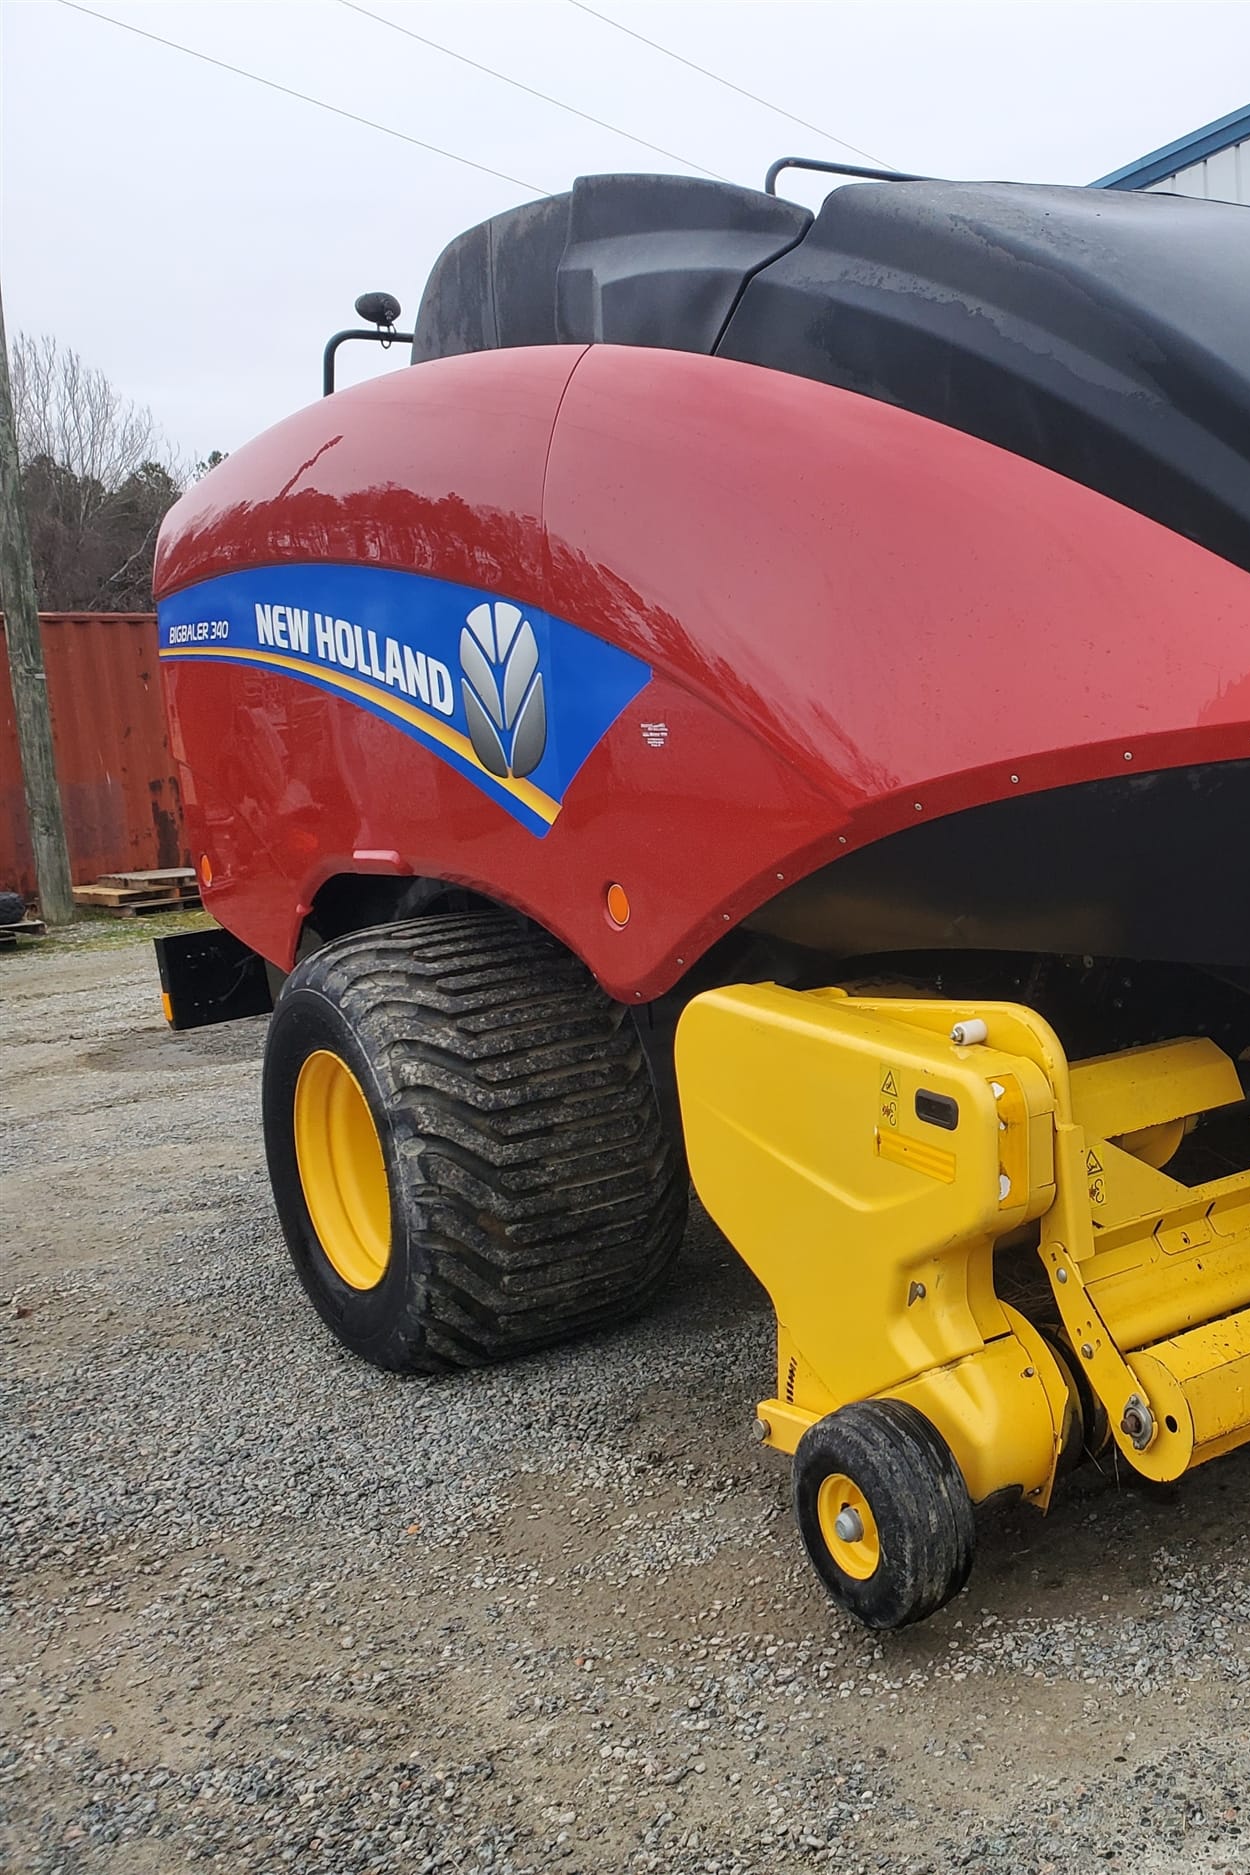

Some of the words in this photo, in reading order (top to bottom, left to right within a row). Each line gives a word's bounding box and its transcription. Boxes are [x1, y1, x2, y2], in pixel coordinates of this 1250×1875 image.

[169, 622, 209, 644] BIGBALER
[210, 620, 229, 640] 340
[255, 603, 309, 654] NEW
[314, 612, 454, 716] HOLLAND
